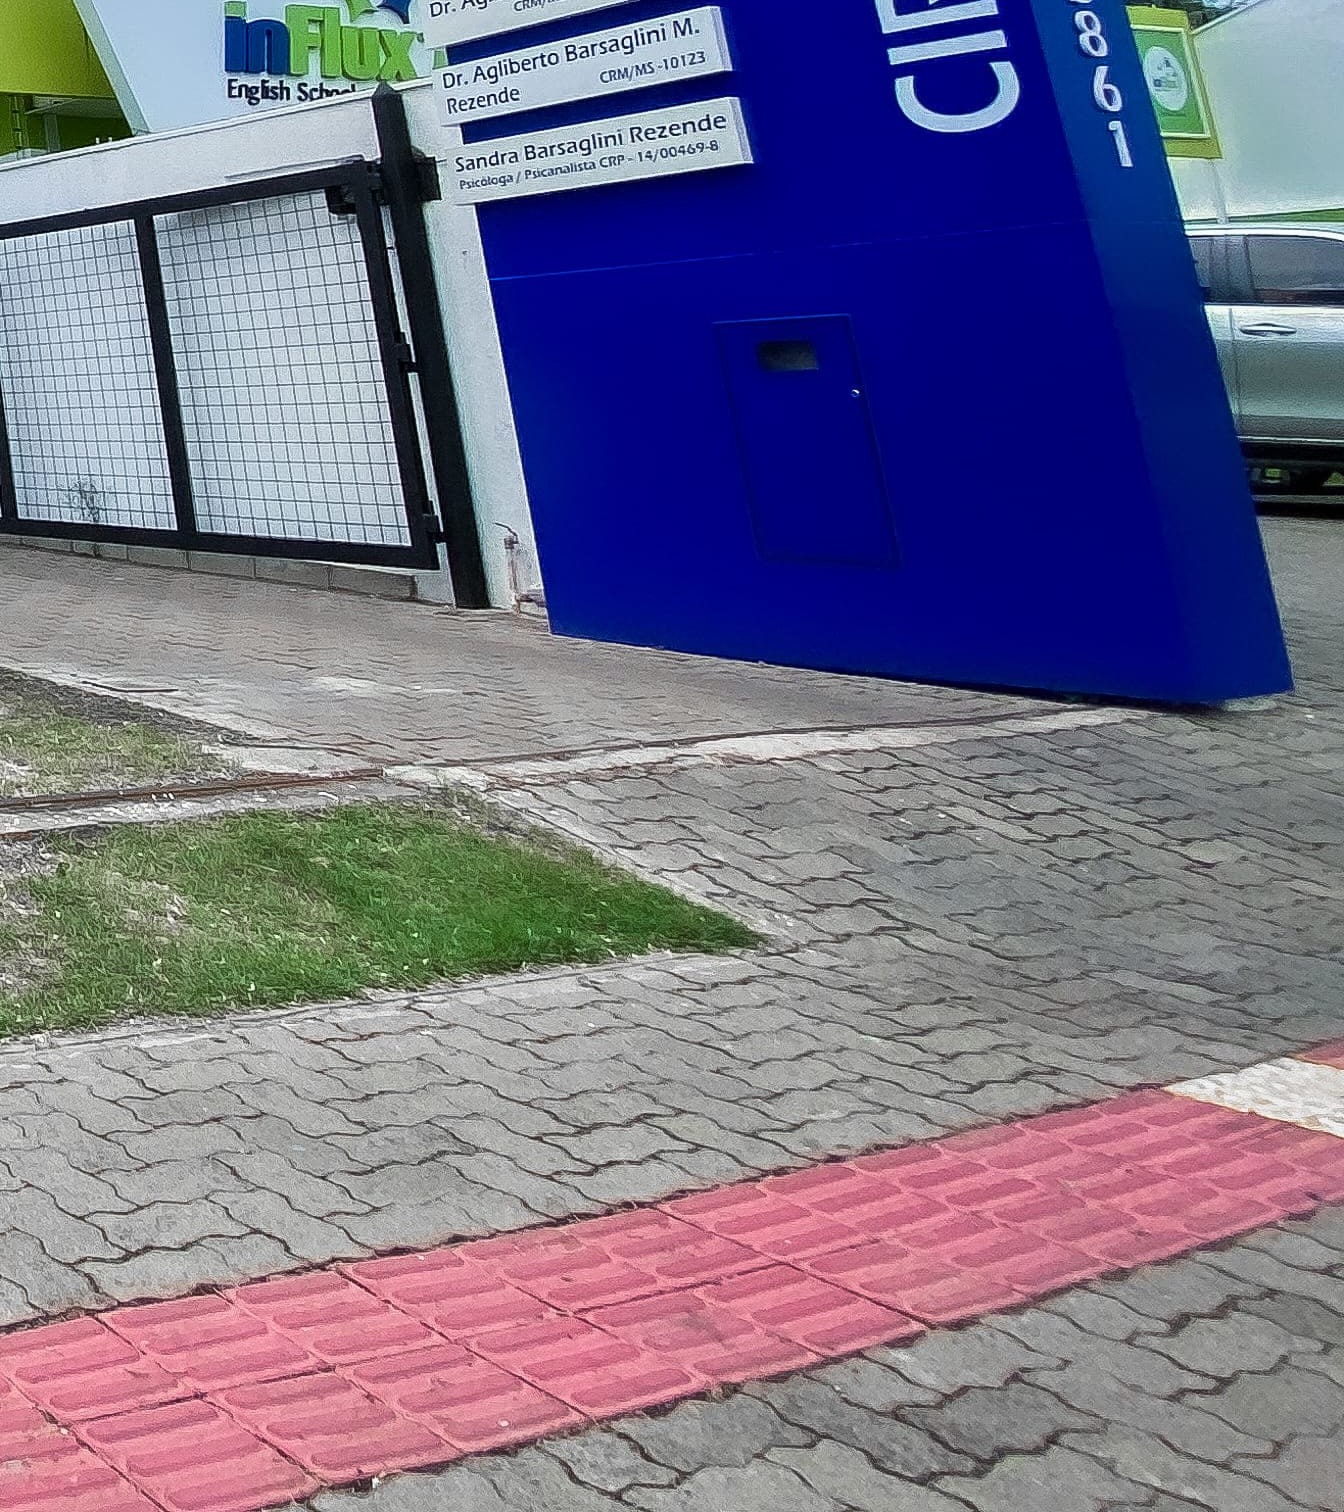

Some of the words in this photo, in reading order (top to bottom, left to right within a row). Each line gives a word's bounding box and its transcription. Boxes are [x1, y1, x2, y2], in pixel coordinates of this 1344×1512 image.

[429, 0, 457, 18] Dr.
[442, 71, 469, 90] Dr.
[472, 51, 560, 85] Agliberto
[565, 22, 667, 63] Barsaglini
[672, 18, 700, 39] M.
[599, 60, 656, 84] CRM/MS
[227, 78, 291, 106] English
[446, 86, 521, 115] Rezende
[455, 149, 519, 173] Sandra
[523, 128, 624, 162] Barsaglini
[630, 113, 728, 145] Rezende
[524, 159, 597, 181] Psicanalista
[599, 154, 626, 169] CRP
